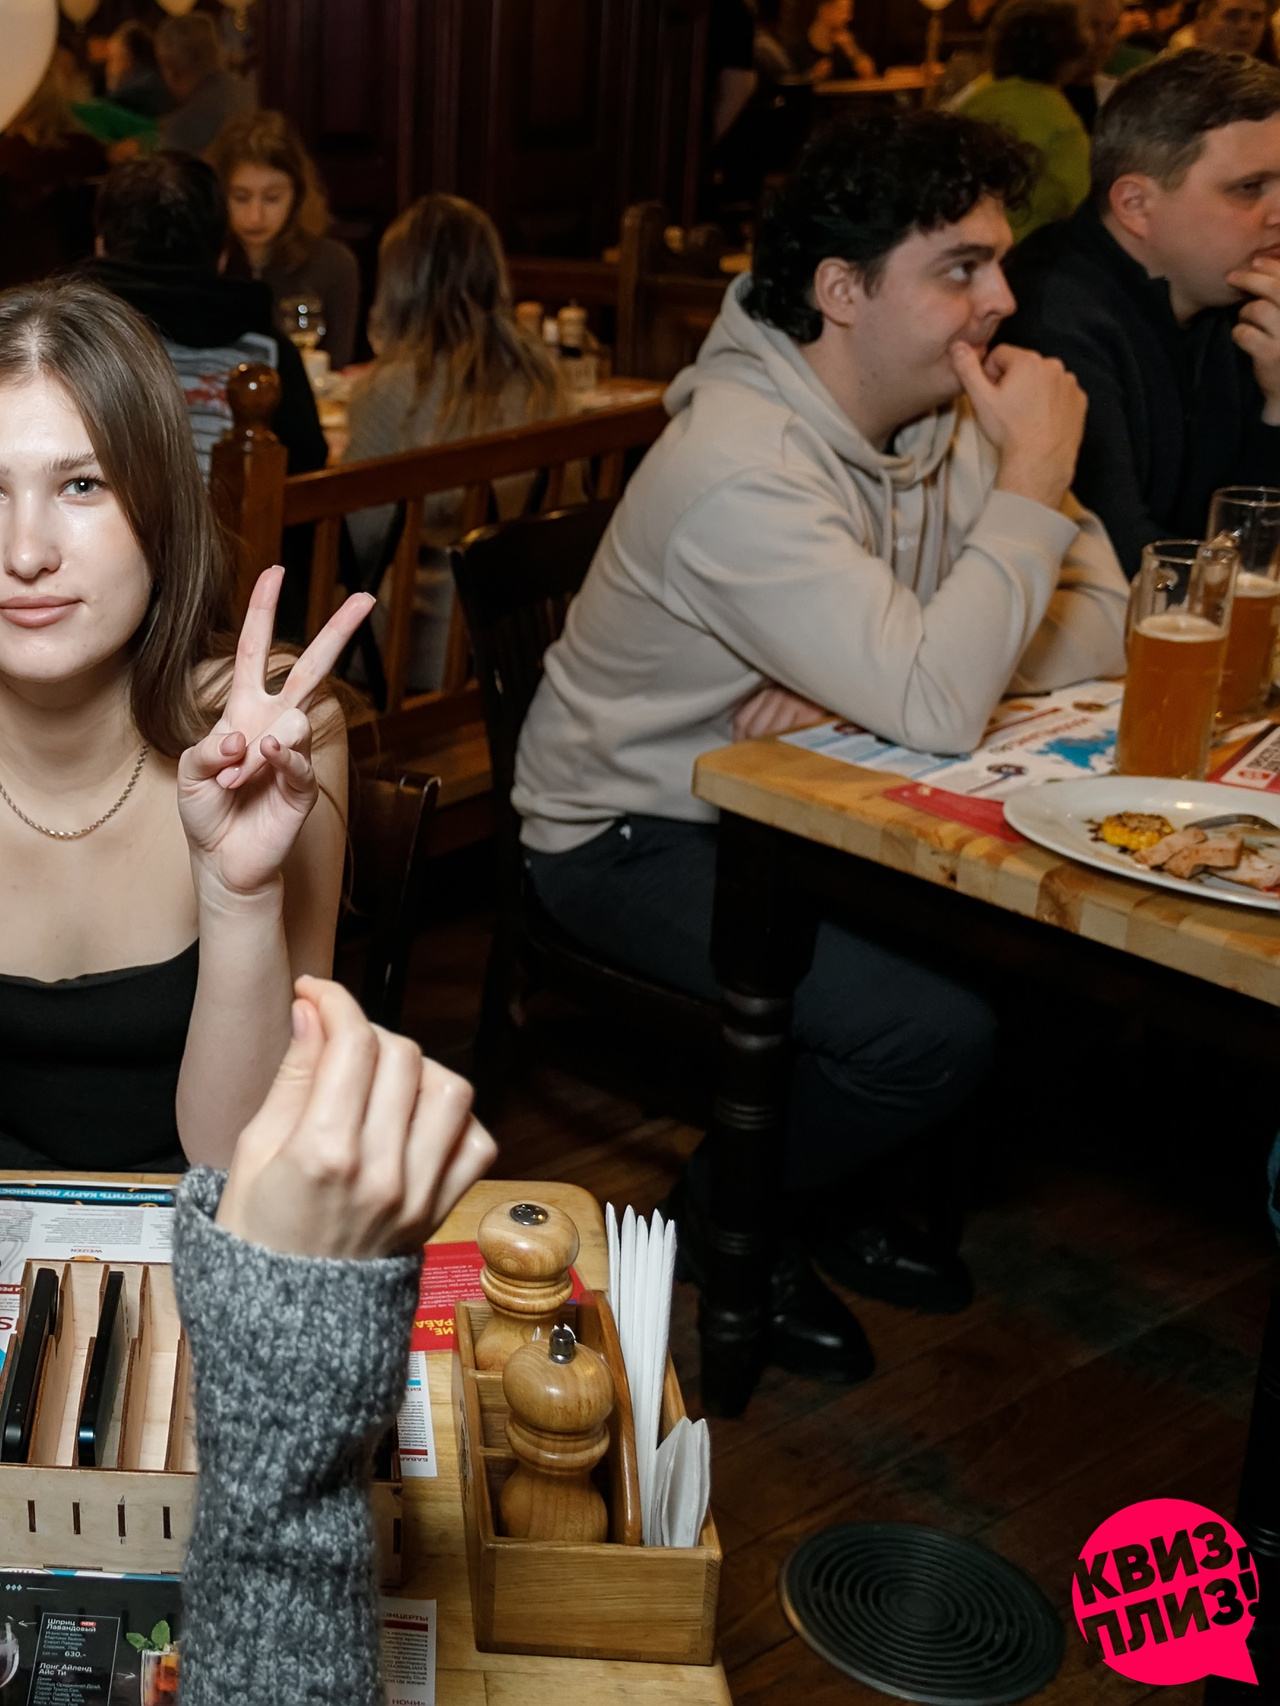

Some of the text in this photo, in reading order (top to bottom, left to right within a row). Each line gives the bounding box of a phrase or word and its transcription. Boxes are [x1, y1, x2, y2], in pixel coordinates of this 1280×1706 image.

[63, 1190, 97, 1199] КАРТУ
[99, 1192, 165, 1201] ВЫПУСТИТЬ
[413, 1318, 454, 1329] РАБА
[429, 1327, 454, 1336] ИЕ,
[383, 1612, 429, 1621] ОНЦЕРТЫ
[47, 1618, 76, 1626] Шприц
[46, 1624, 96, 1633] Лавандовый
[39, 1662, 92, 1673] Лонг Айленд
